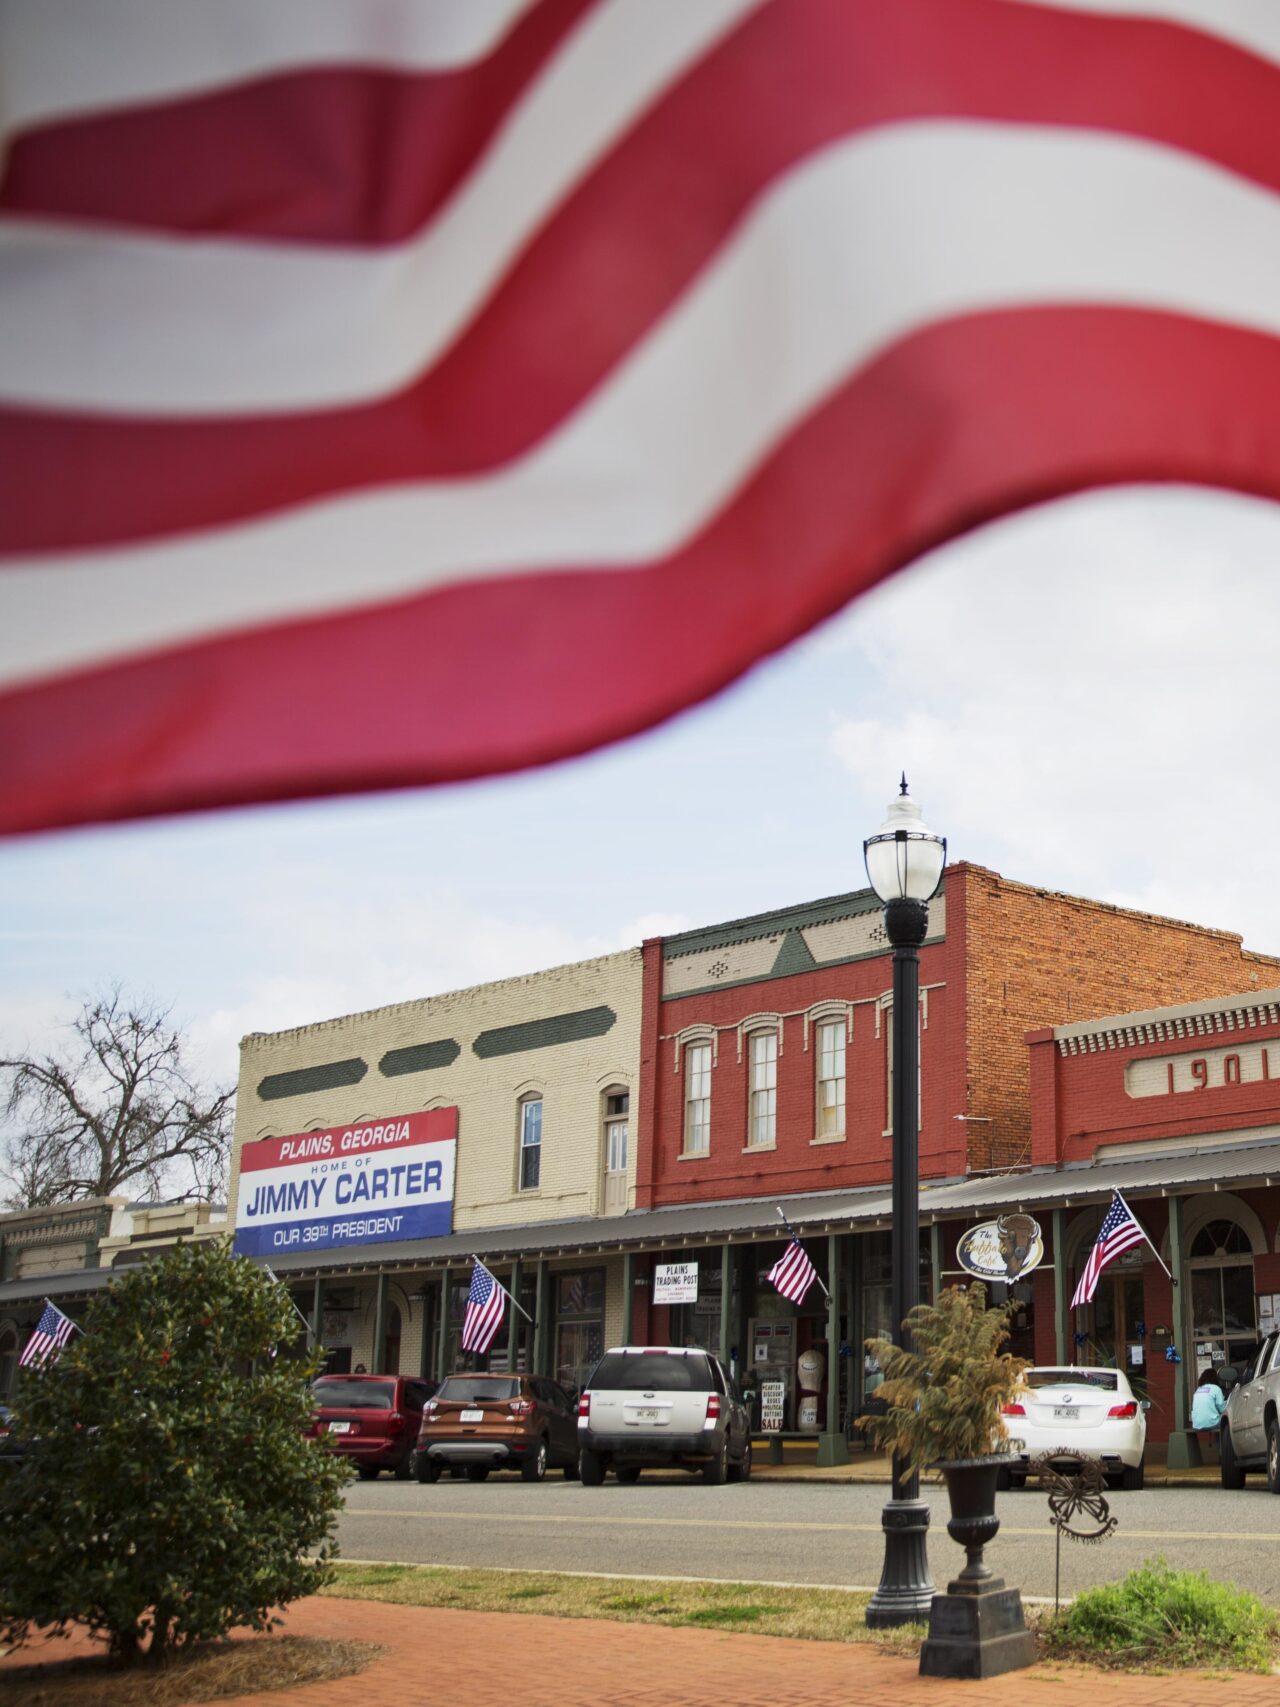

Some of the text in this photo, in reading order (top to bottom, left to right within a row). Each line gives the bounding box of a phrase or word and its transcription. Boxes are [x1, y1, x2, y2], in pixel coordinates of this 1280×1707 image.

[1167, 1048, 1269, 1094] 1901
[279, 1121, 411, 1160] PLAINS, GEORGIA
[311, 1157, 373, 1174] HOME OF
[246, 1159, 443, 1216] JIMMY CARTER
[273, 1215, 404, 1246] OUR 39TH PRESIDENT
[980, 1230, 993, 1239] The
[666, 1265, 689, 1275] PLAINS
[656, 1274, 698, 1286] TRADING POST
[761, 1419, 783, 1430] SALE
